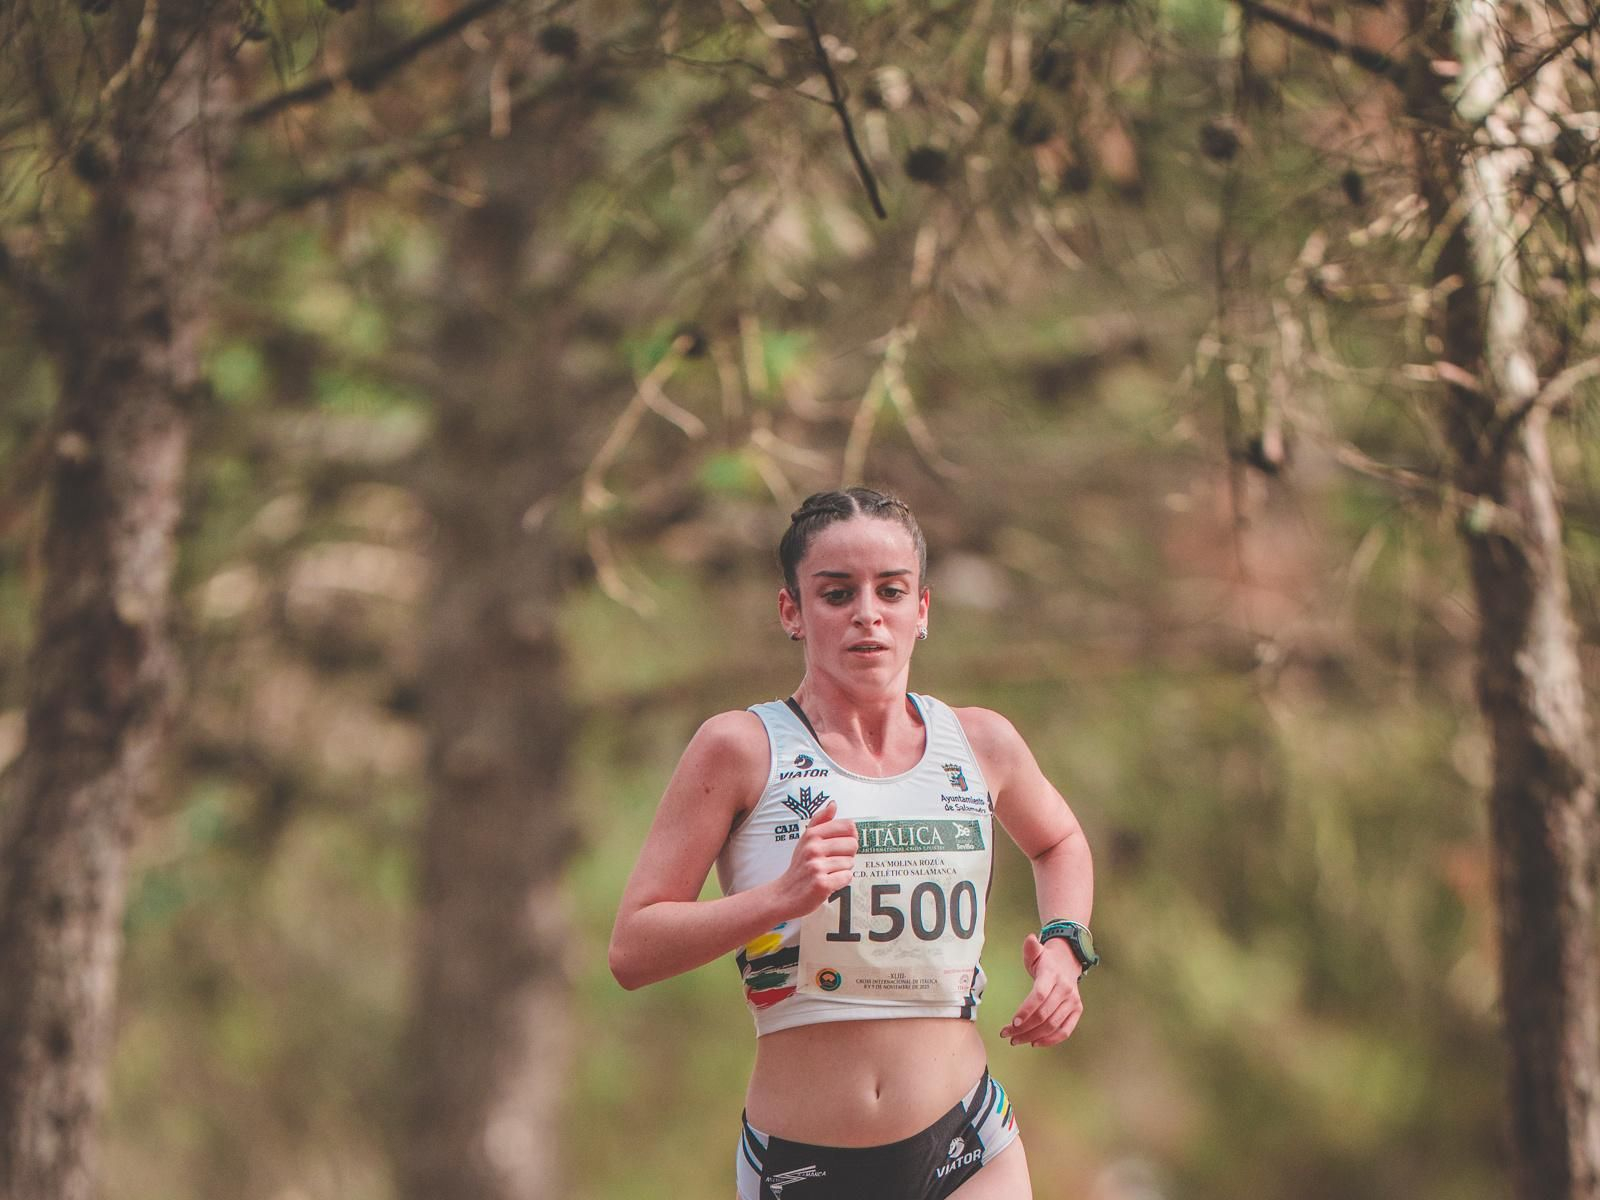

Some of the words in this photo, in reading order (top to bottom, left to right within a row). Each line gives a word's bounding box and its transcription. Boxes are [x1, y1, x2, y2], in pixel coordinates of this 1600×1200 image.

[780, 768, 829, 780] VIATOR
[775, 823, 799, 834] CAJA
[861, 823, 945, 847] ITÁLICA
[887, 860, 918, 868] MOLINA
[919, 857, 945, 866] ROZÚA
[870, 868, 909, 878] ATLÉTICO
[910, 867, 957, 876] SALAMANCA
[826, 880, 978, 943] 1500
[936, 1149, 981, 1178] VIATOR
